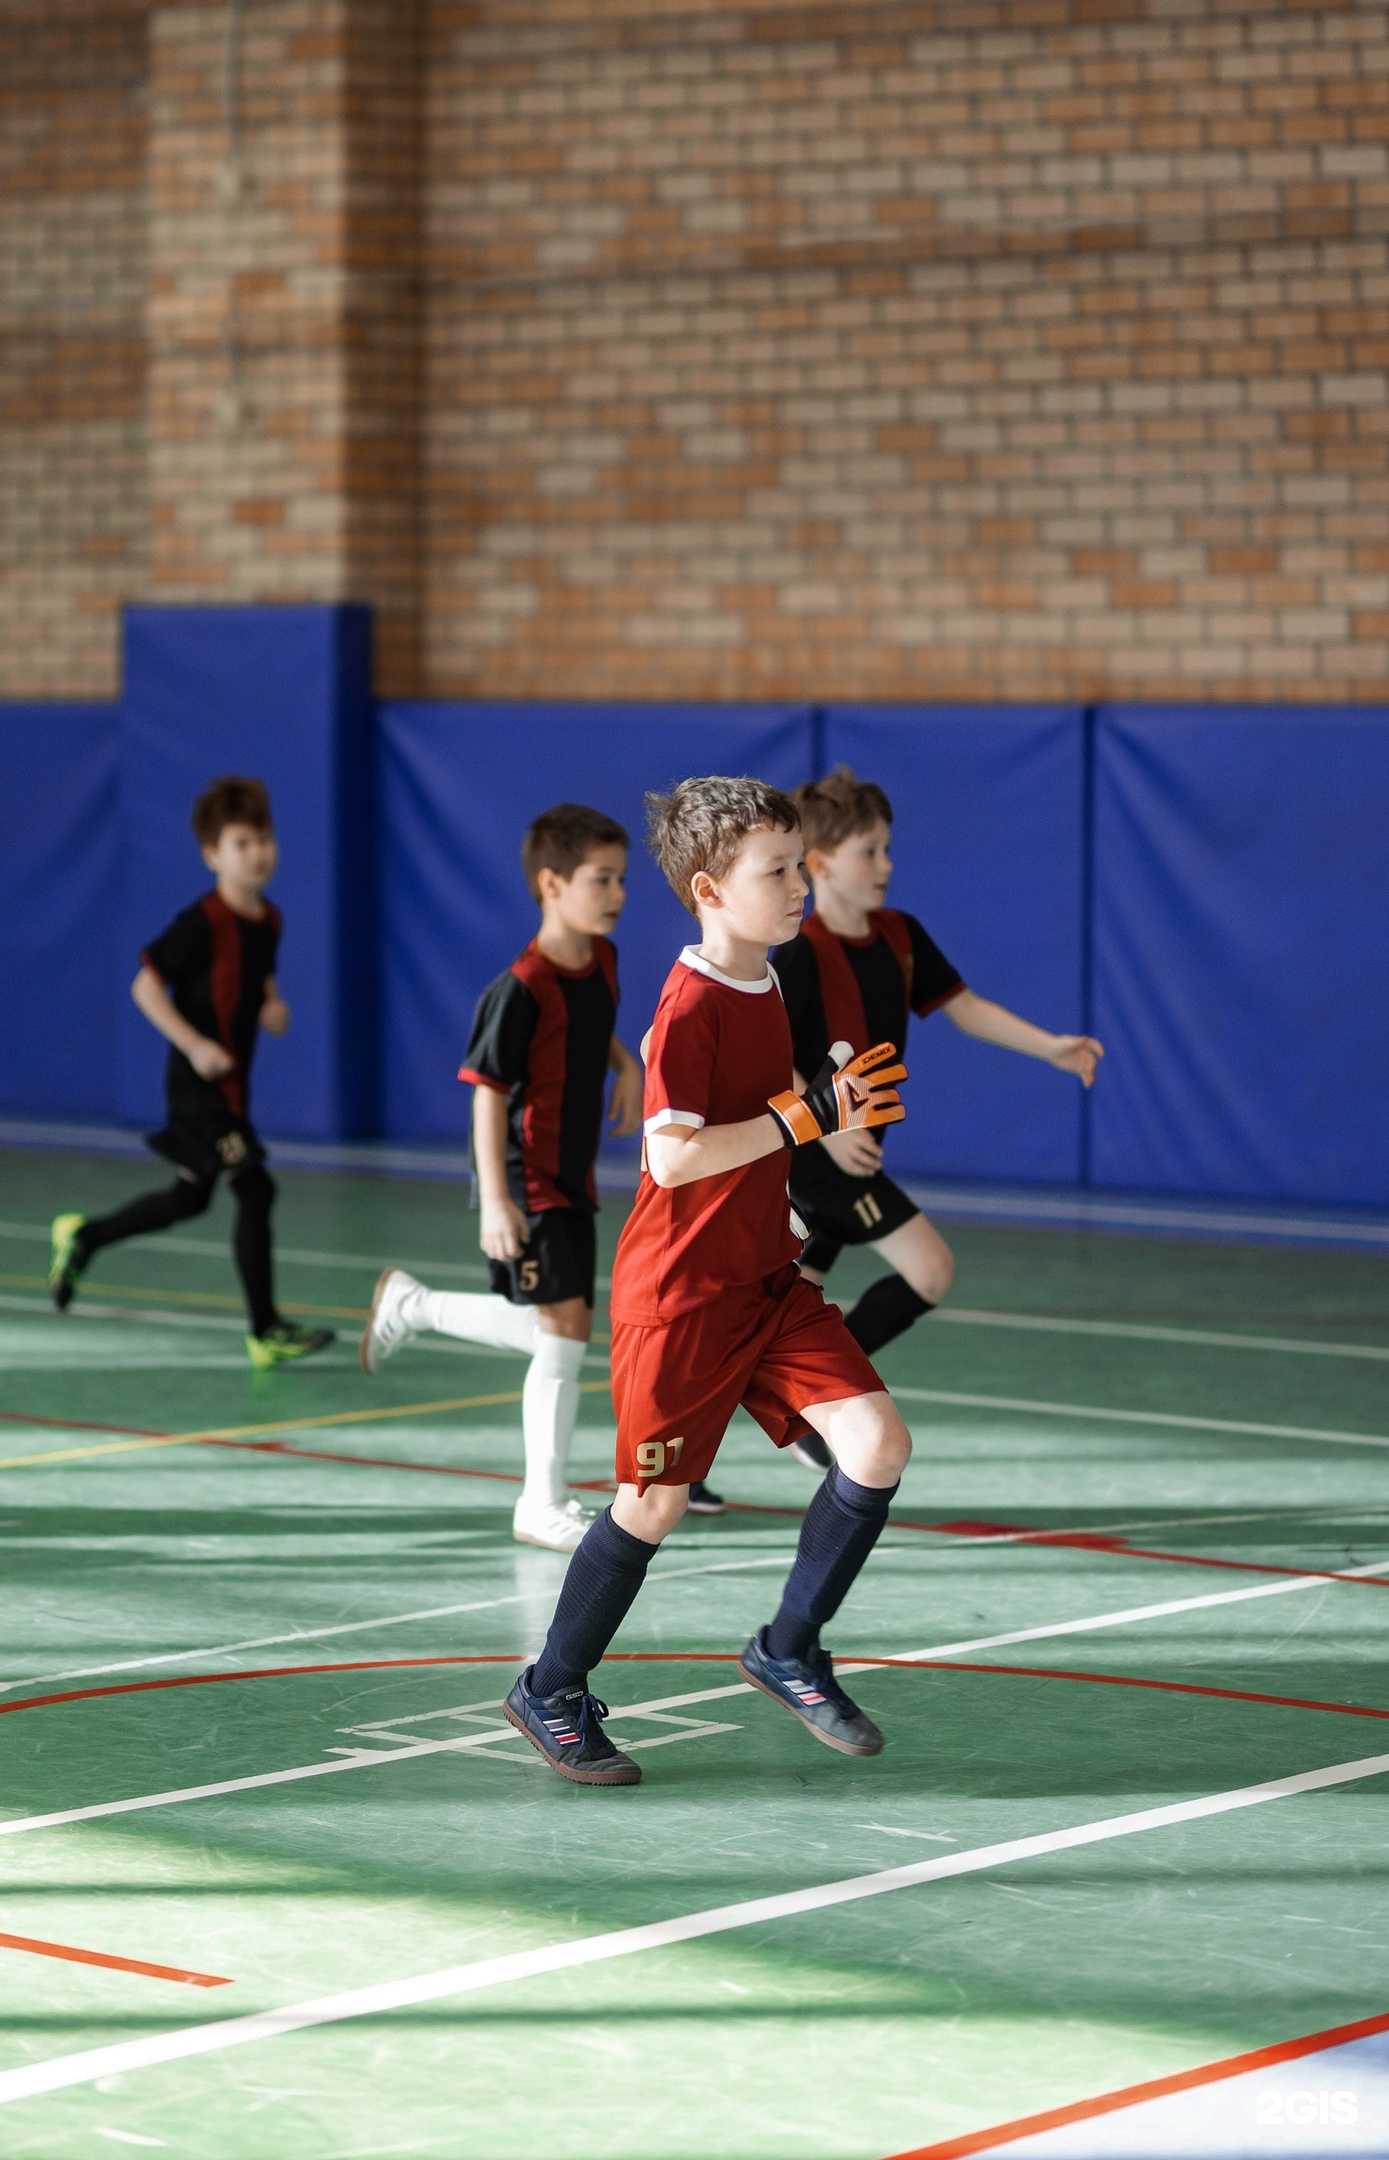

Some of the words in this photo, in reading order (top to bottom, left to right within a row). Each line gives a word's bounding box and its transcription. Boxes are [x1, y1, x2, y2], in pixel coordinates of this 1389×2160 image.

[862, 1045, 892, 1065] DEMIX
[853, 1192, 883, 1229] 11
[520, 1260, 540, 1291] 5
[636, 1436, 685, 1478] 91
